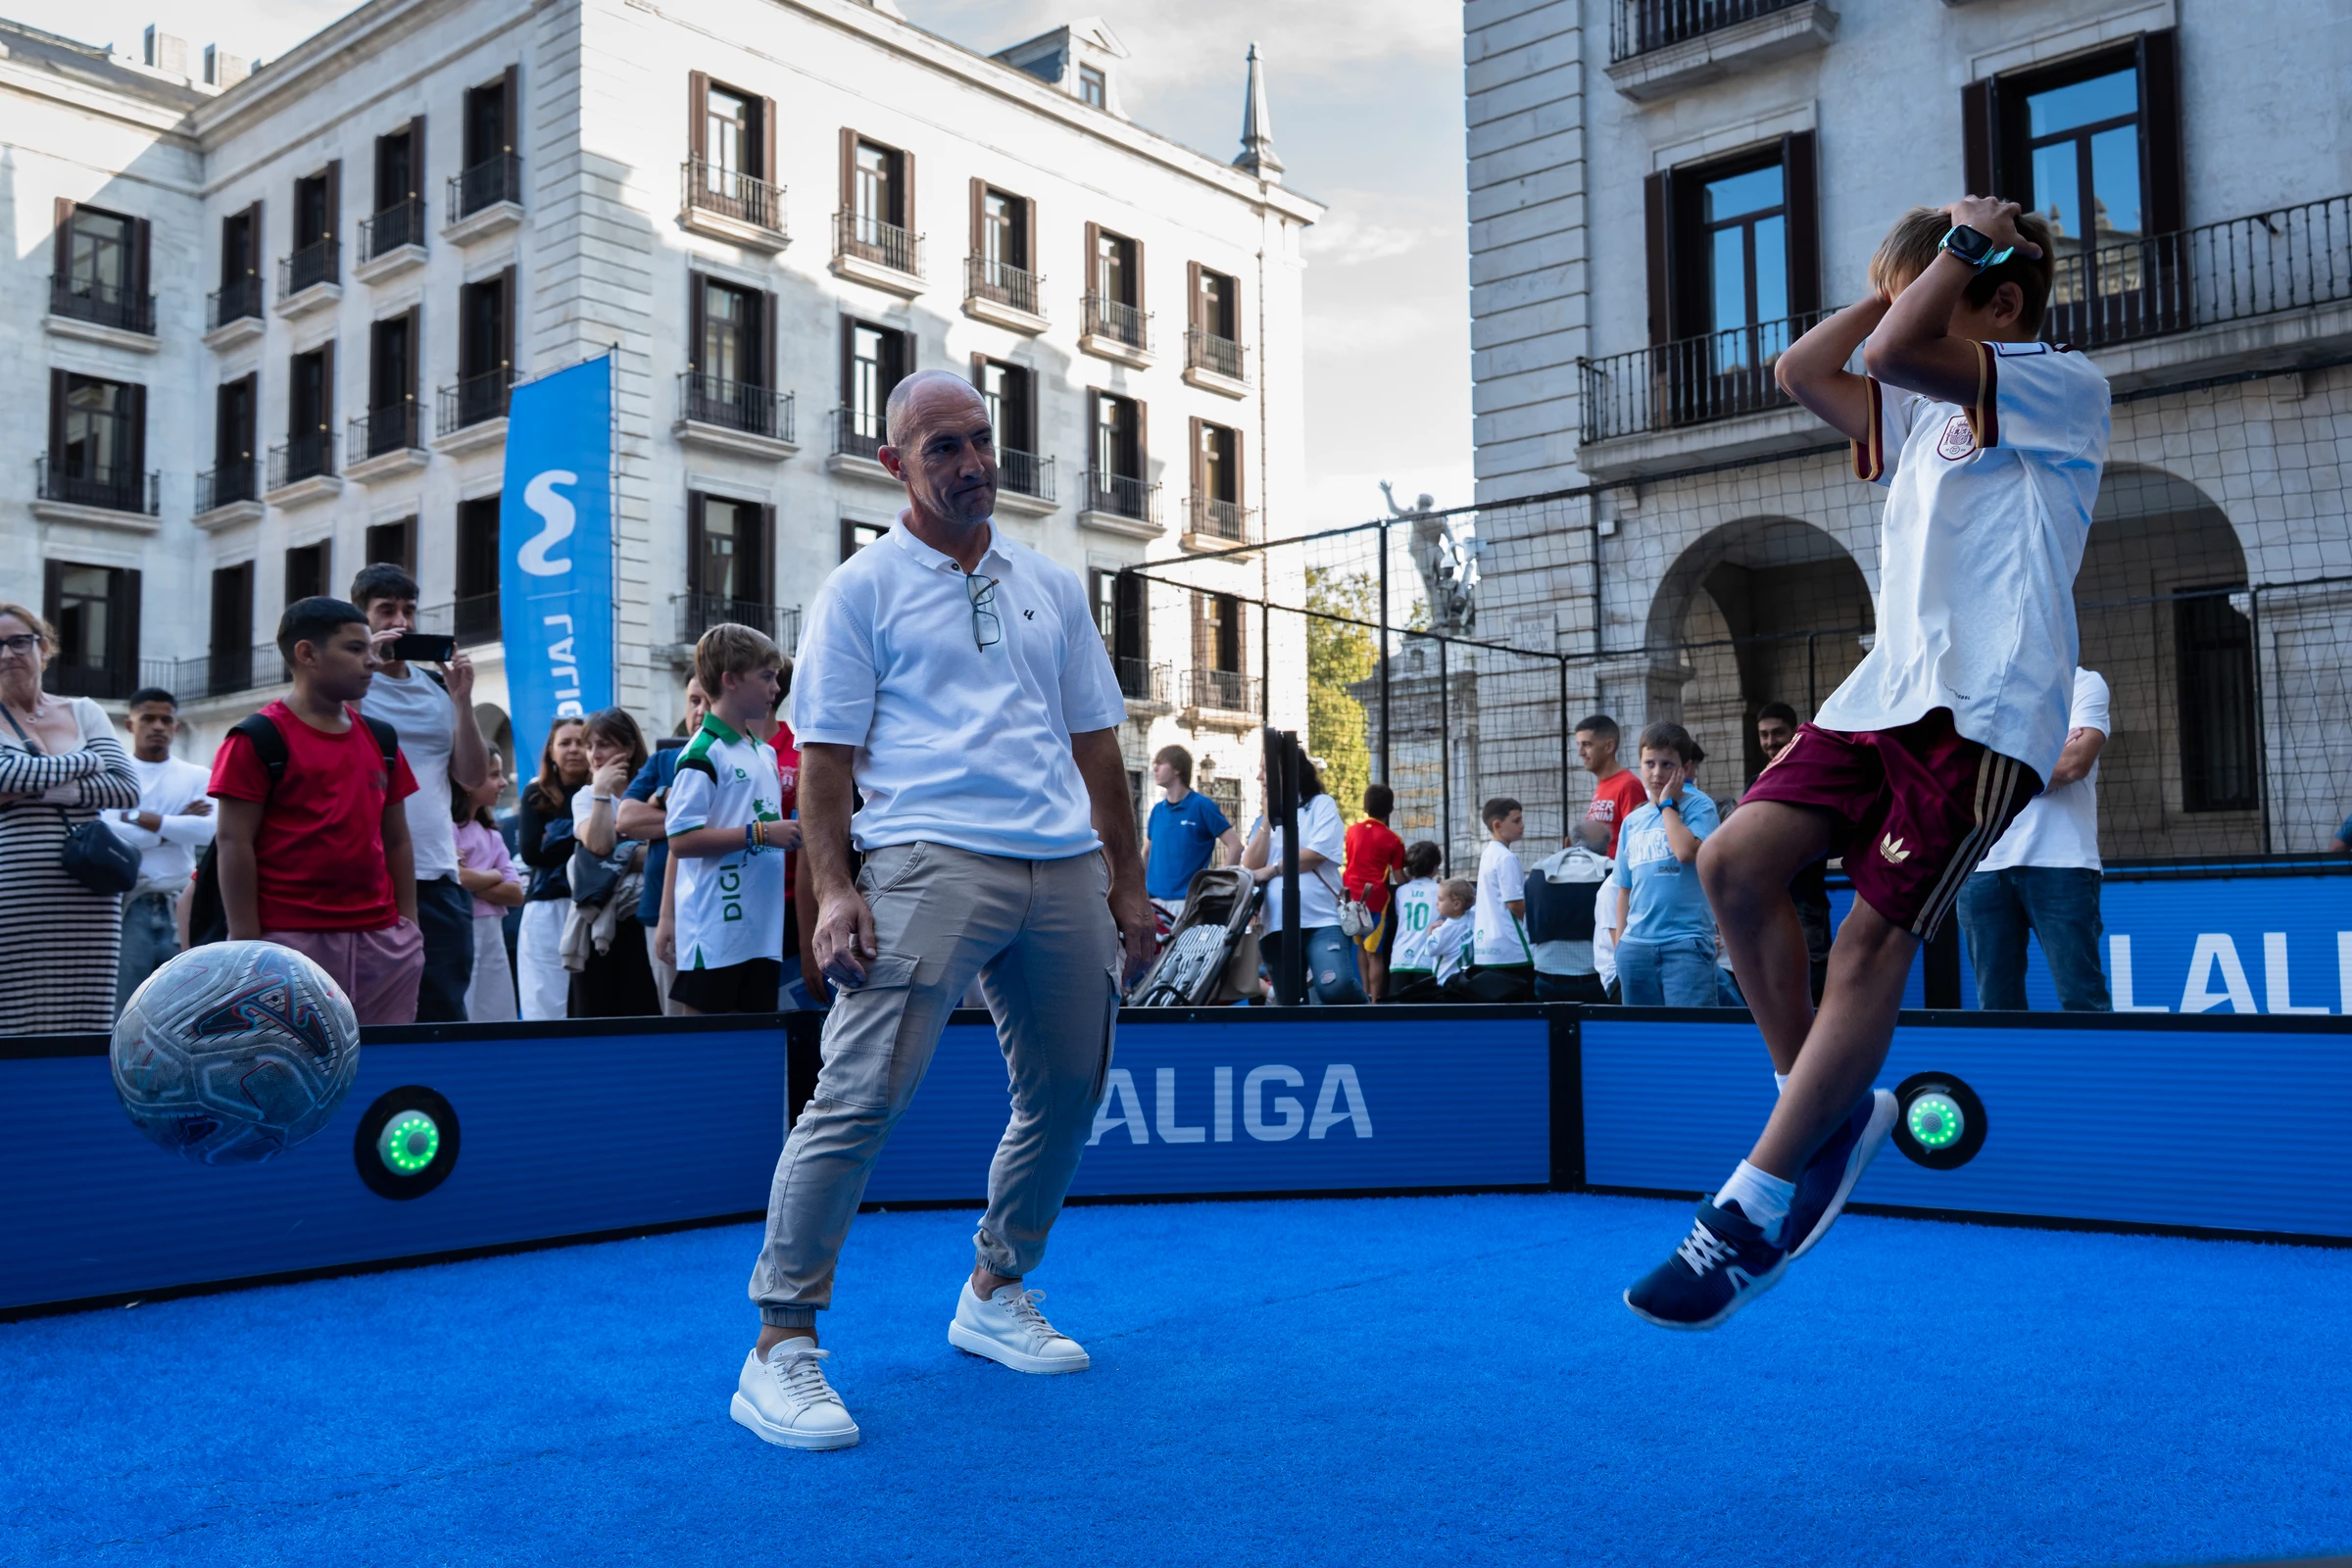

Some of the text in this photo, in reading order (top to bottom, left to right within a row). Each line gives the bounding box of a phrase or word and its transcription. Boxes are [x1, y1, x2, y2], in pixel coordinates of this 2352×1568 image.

[719, 863, 742, 922] DIGI
[1403, 902, 1430, 931] 10
[1085, 1064, 1373, 1146] ALIGA
